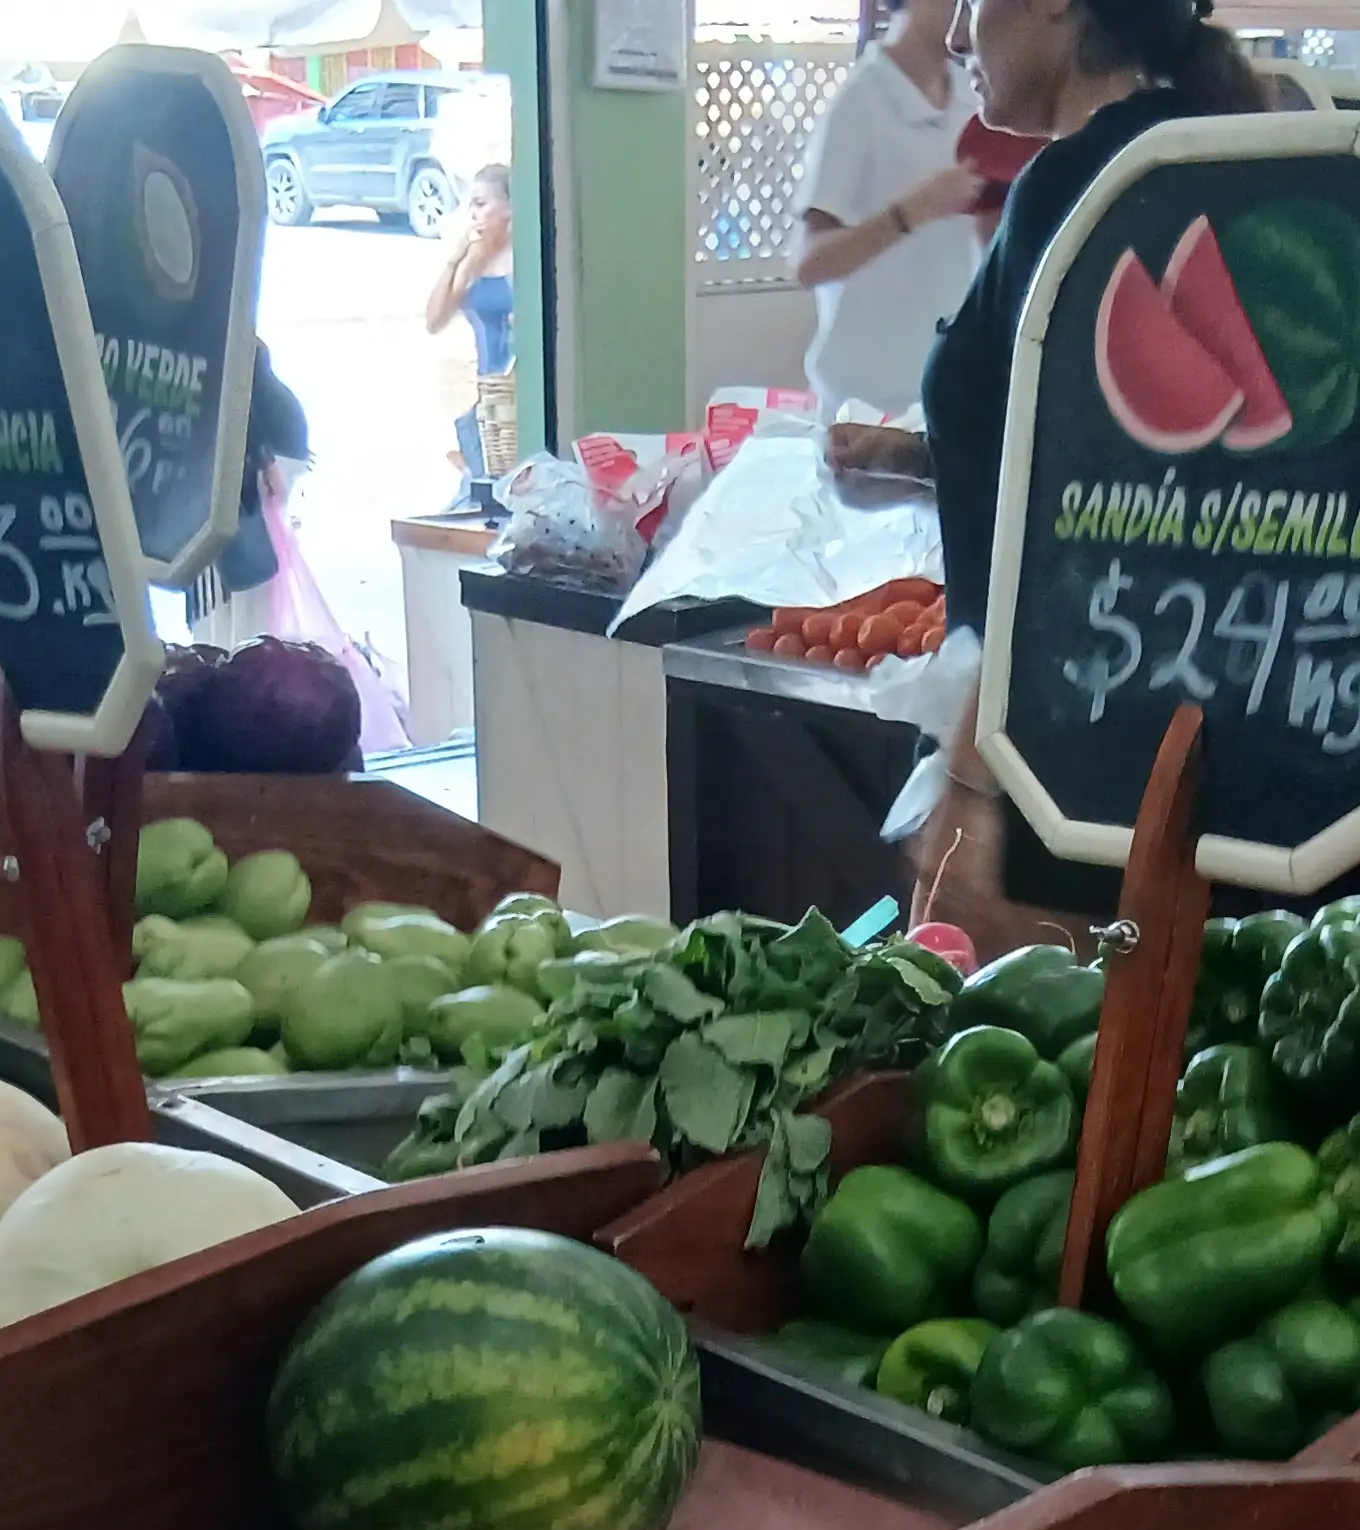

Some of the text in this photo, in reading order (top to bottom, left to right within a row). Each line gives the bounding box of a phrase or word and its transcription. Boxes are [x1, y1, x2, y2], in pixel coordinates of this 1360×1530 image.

[124, 338, 207, 419] VERDE
[1054, 467, 1187, 546] SANDÍA
[1063, 557, 1290, 726] $24
